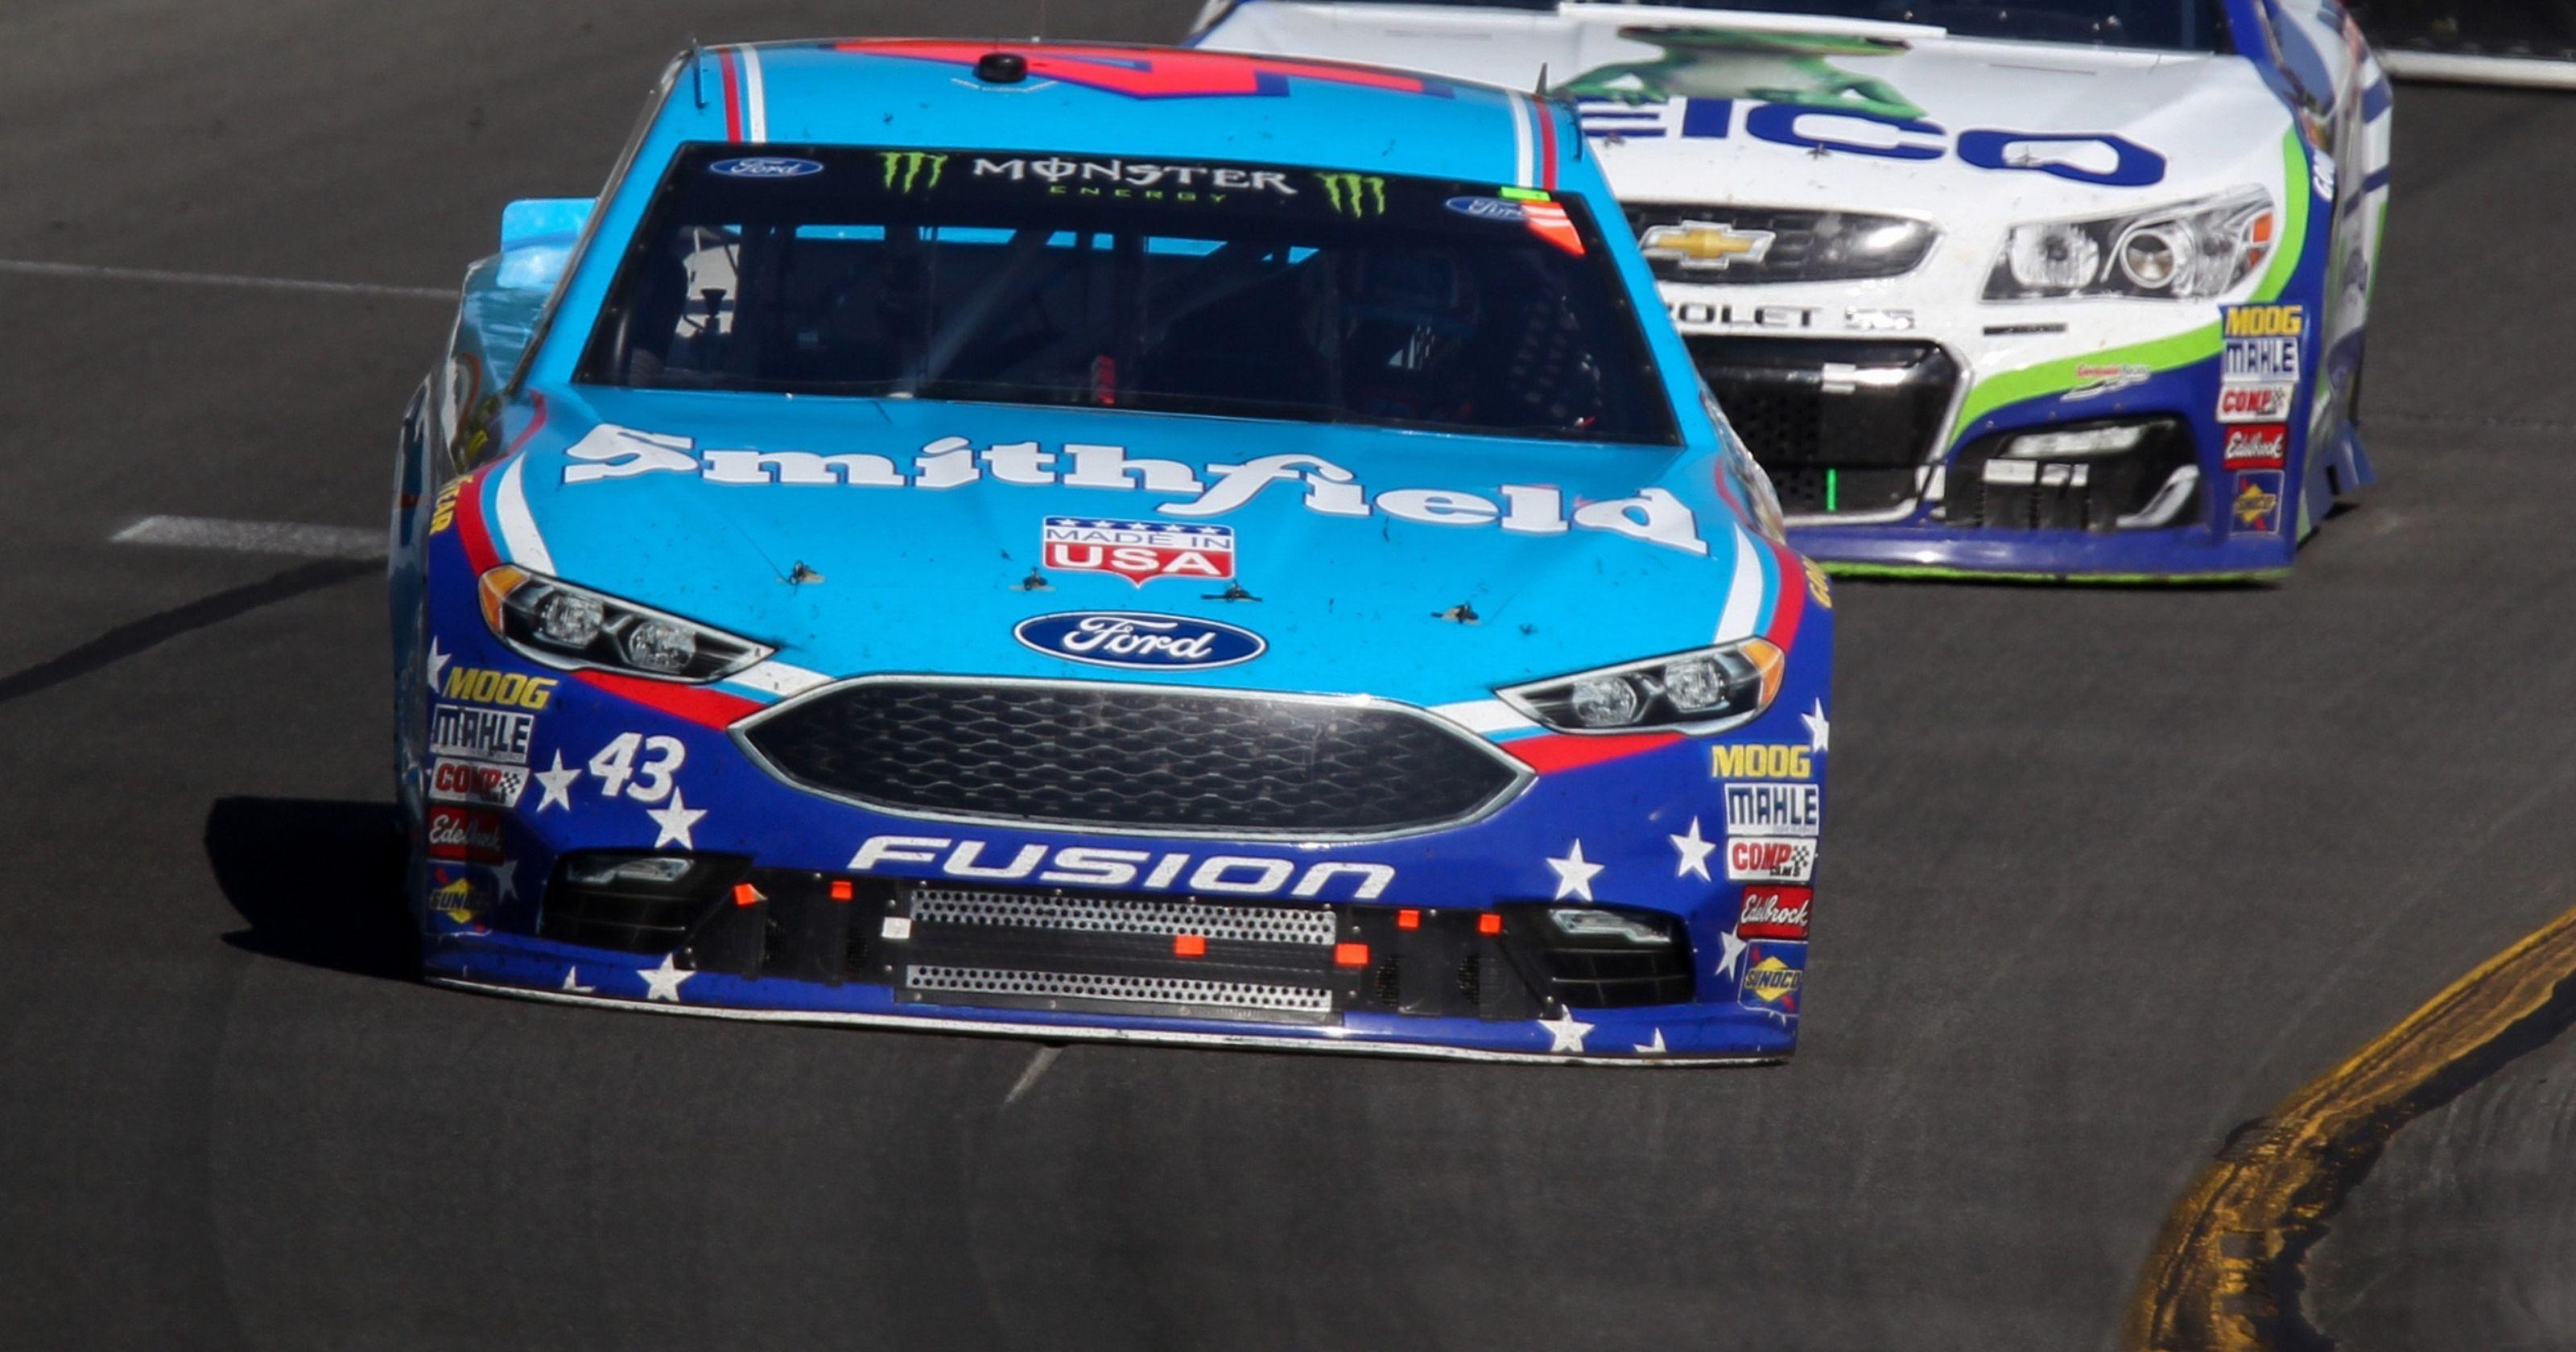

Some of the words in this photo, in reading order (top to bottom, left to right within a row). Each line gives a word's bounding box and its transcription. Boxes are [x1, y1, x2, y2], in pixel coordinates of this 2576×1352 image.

[1578, 94, 2168, 187] EICO
[730, 159, 803, 175] Ford
[972, 157, 1299, 195] MONSTER
[1049, 185, 1228, 203] ENERGY
[2224, 304, 2304, 337] MOOG
[2225, 341, 2294, 373] MAHLE
[2222, 390, 2273, 414] COMP
[564, 422, 1711, 556] Smithfield
[1046, 528, 1174, 547] MADE
[1191, 536, 1232, 550] IN
[1053, 543, 1221, 576] USA
[1062, 616, 1216, 659] Ford
[442, 666, 559, 710] MOOG
[432, 708, 530, 755] MAHLE
[435, 761, 504, 795] COMP
[588, 732, 687, 802] 43
[1711, 743, 1812, 779] MOOG
[1727, 786, 1818, 826] MAHLE
[846, 835, 1397, 900] FUSION
[1732, 842, 1793, 871] COMP
[1740, 893, 1810, 926] Edelbrock
[1744, 968, 1804, 991] SUNOCO
